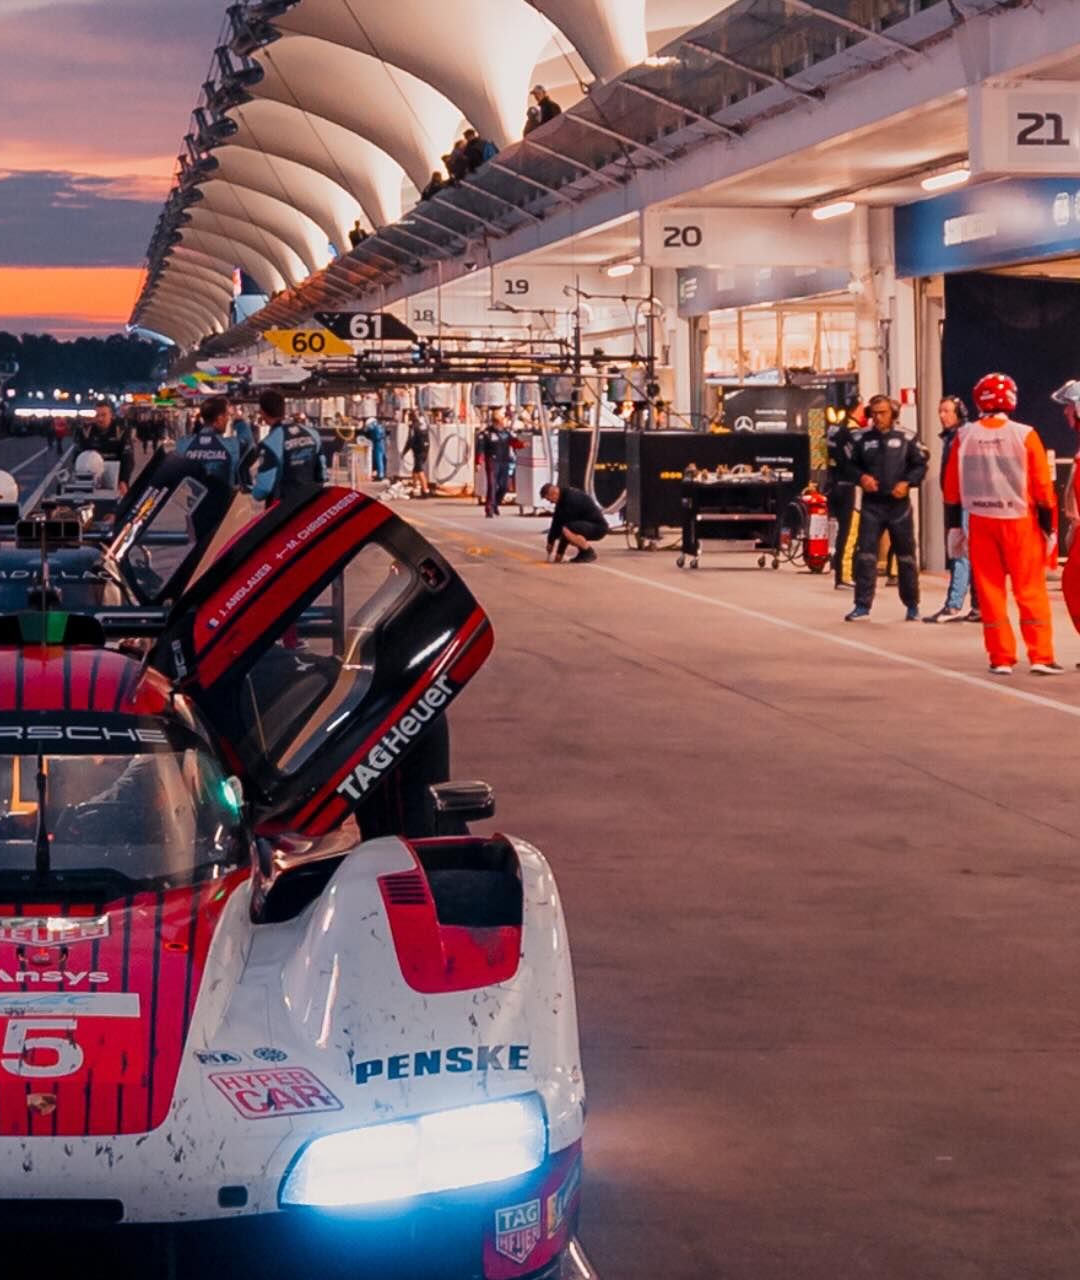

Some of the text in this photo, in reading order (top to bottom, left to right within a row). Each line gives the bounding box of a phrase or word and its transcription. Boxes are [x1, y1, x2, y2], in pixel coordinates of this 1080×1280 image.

[1015, 113, 1070, 147] 21
[663, 226, 702, 247] 20
[504, 279, 529, 295] 19
[349, 314, 382, 338] 61
[414, 309, 435, 322] 18
[291, 332, 325, 353] 60
[285, 436, 314, 450] OFFICIAL
[296, 491, 361, 540] CHRISTENSEN
[224, 563, 272, 611] ANDLAUER
[1, 1019, 84, 1078] 5
[355, 1045, 529, 1085] PENSKE
[221, 1071, 310, 1090] HYPER
[235, 1085, 332, 1113] CAR
[500, 1204, 537, 1229] TAG
